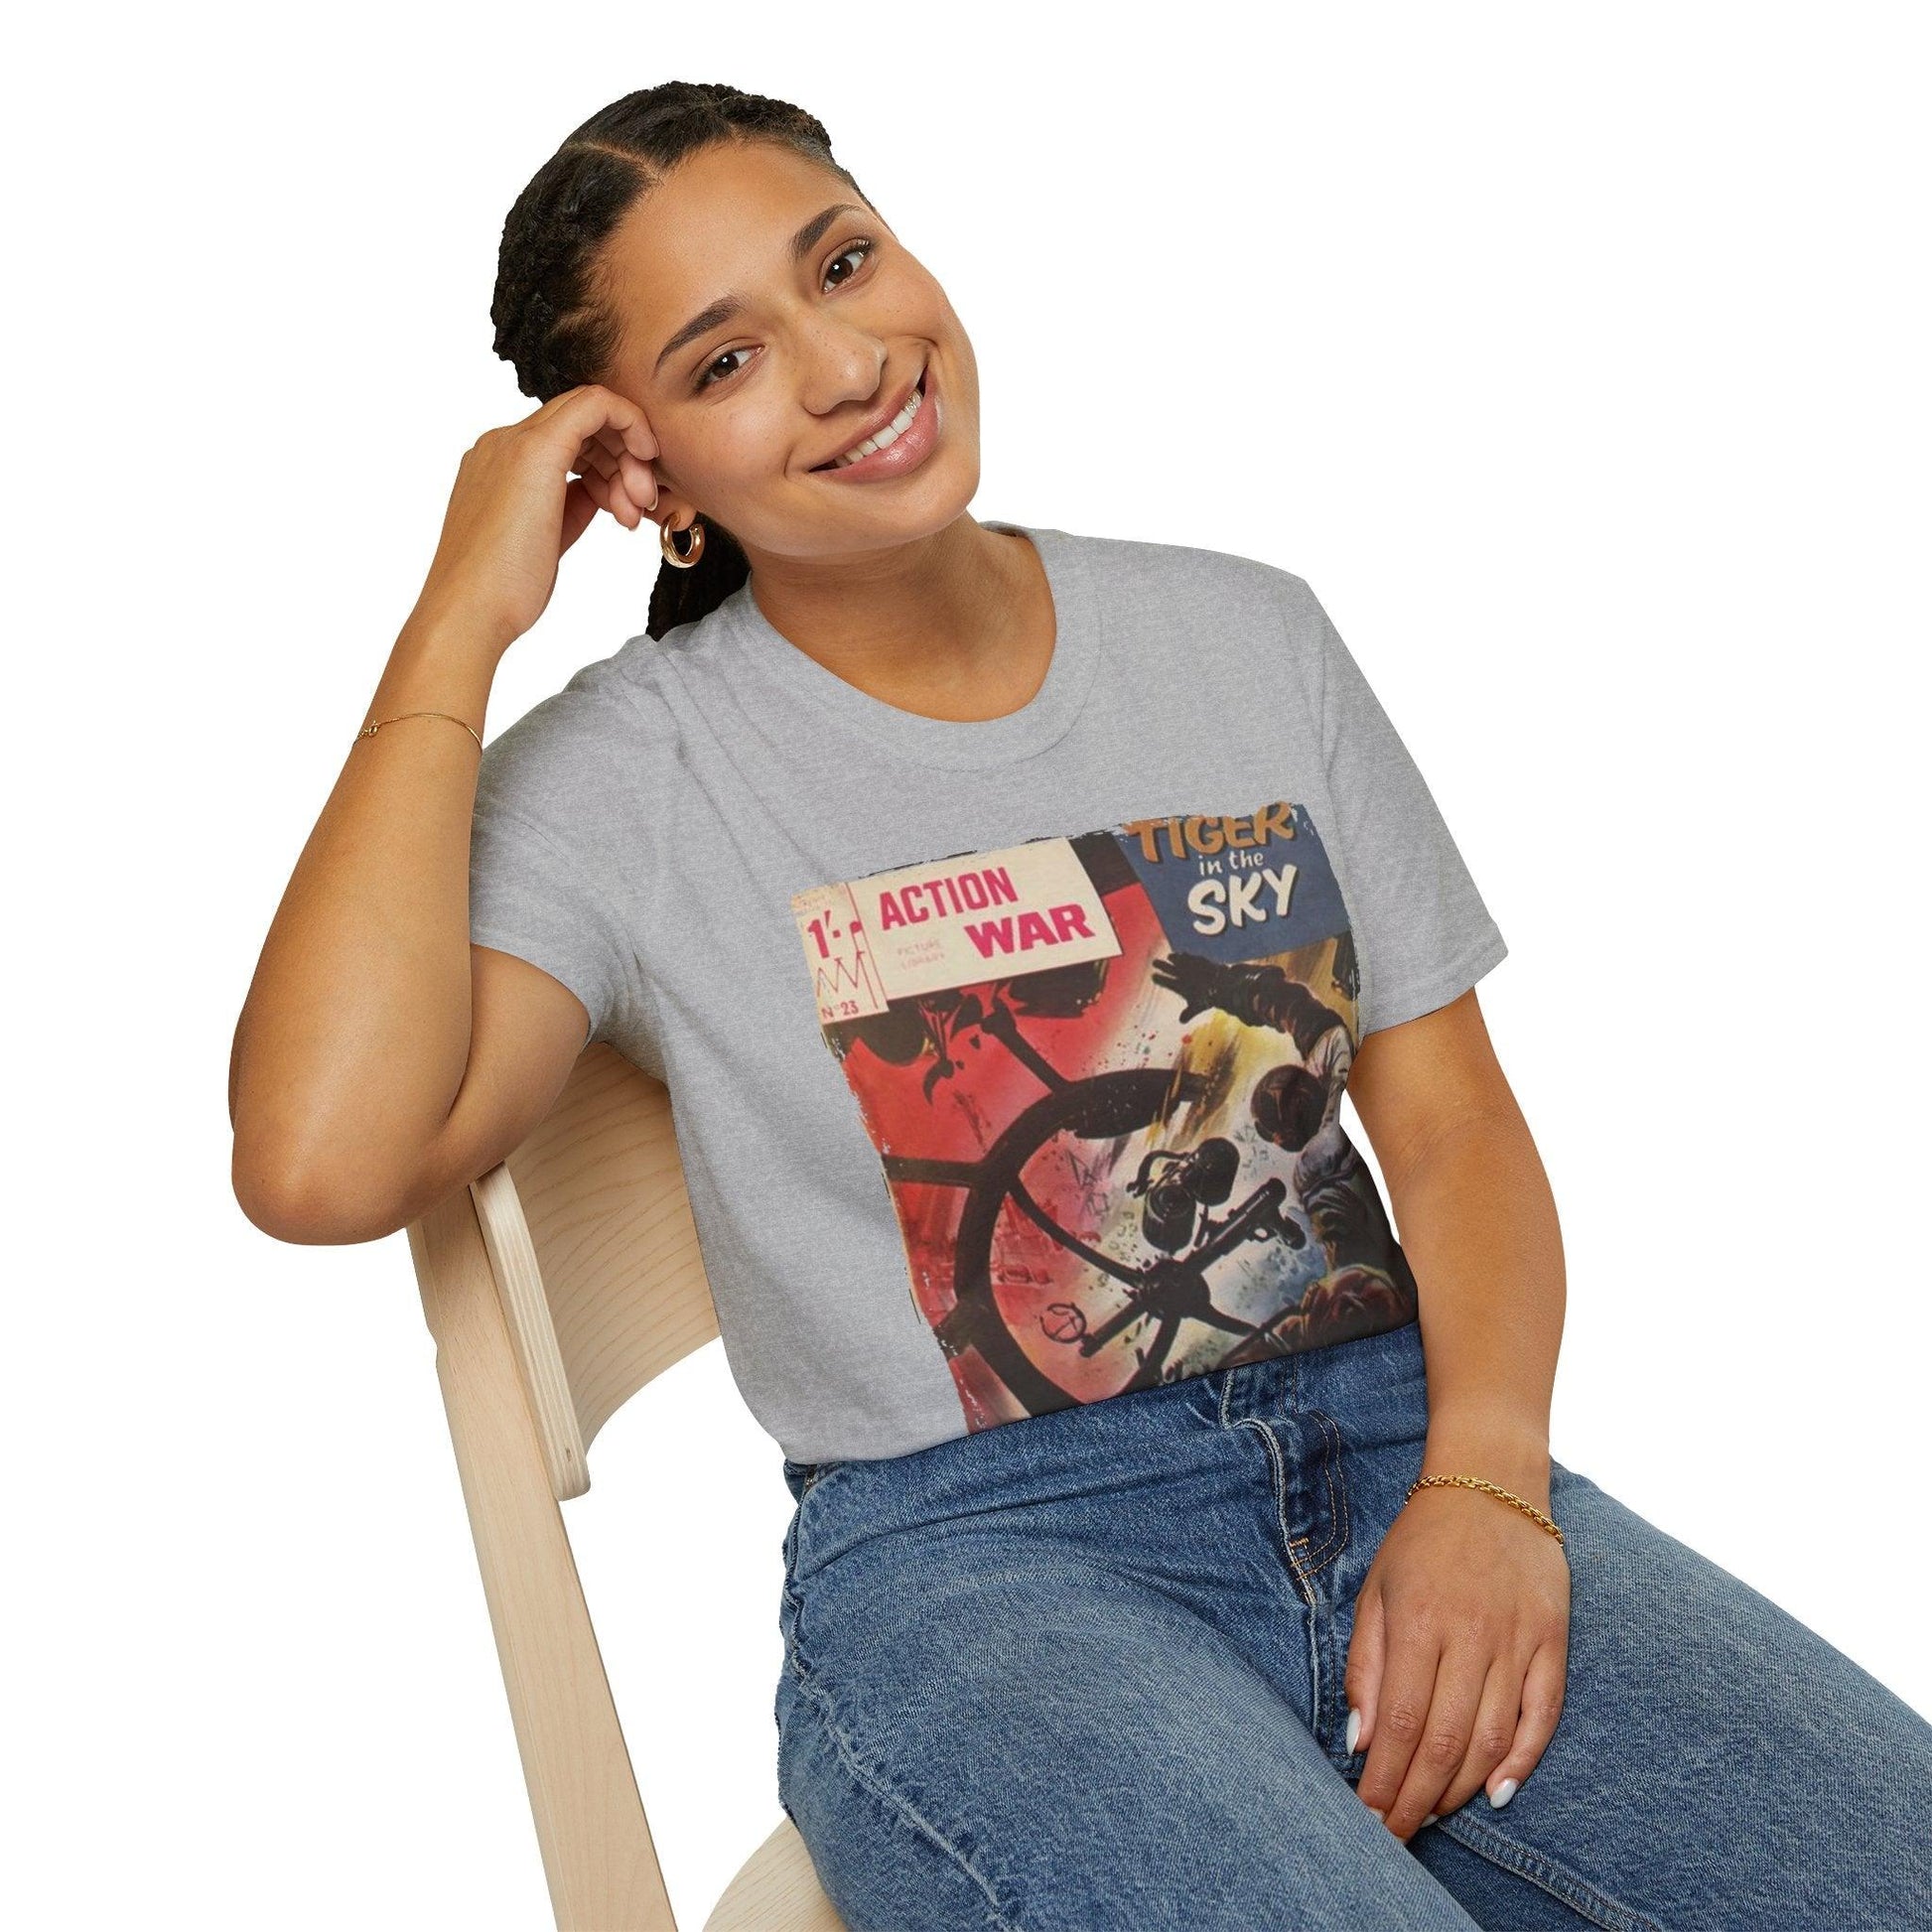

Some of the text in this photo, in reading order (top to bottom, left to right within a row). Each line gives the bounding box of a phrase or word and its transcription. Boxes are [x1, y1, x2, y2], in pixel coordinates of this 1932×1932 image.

[1121, 800, 1296, 864] TIGER
[1197, 849, 1265, 877] in the
[879, 866, 1020, 931] ACTION
[1186, 863, 1299, 936] SKY
[963, 902, 1096, 960] WAR
